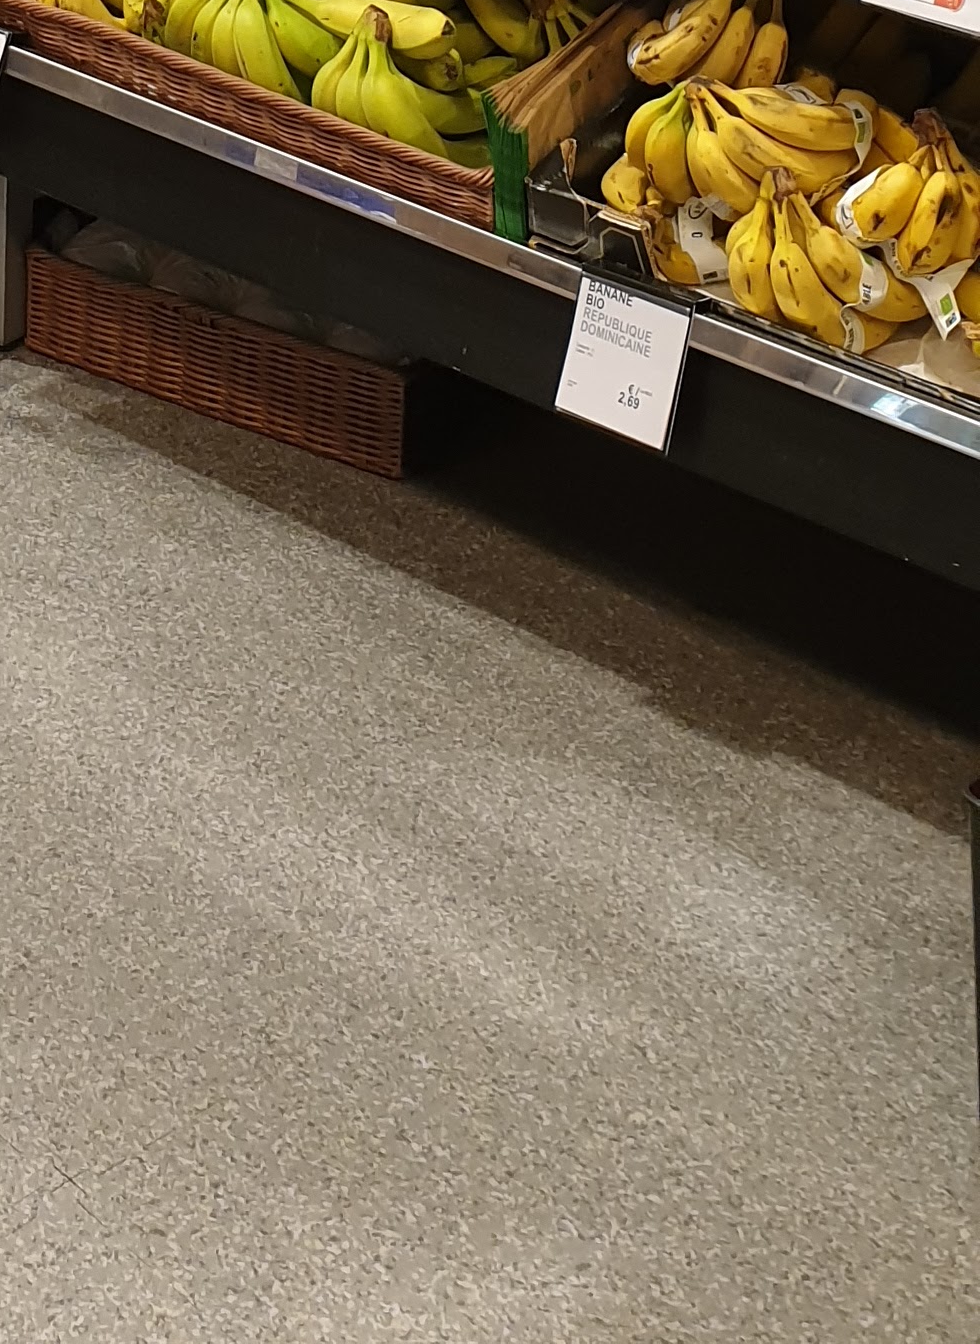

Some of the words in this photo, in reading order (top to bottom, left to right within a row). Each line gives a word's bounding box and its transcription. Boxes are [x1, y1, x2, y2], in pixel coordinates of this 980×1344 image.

[586, 294, 605, 310] BIO
[588, 281, 633, 308] BANANE
[583, 306, 652, 344] REPUBLIQUE
[580, 320, 652, 359] DOMINICAINE
[618, 391, 640, 410] 2,69
